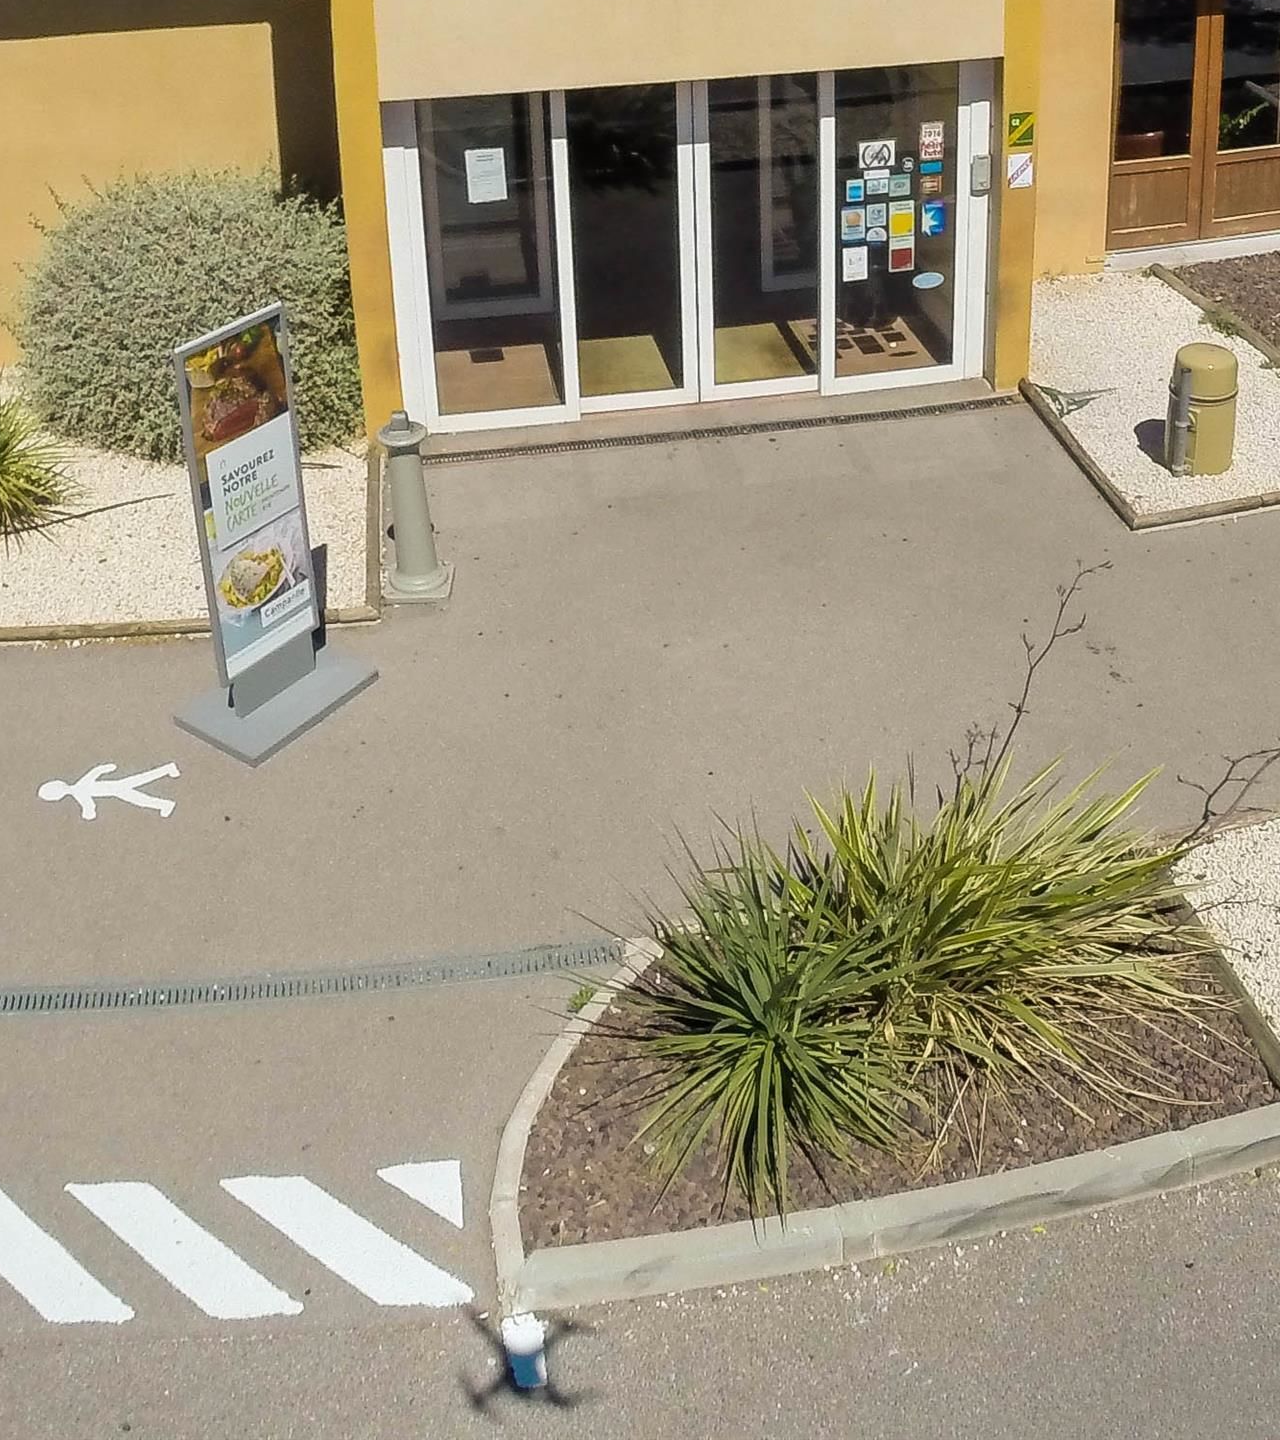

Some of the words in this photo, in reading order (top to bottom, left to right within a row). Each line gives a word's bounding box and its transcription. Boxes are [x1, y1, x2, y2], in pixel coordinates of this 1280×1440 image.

[221, 448, 275, 486] SAVOUREZ
[223, 470, 258, 497] NOTRE
[225, 473, 279, 516] NOUVELLE
[226, 502, 258, 533] CARTE
